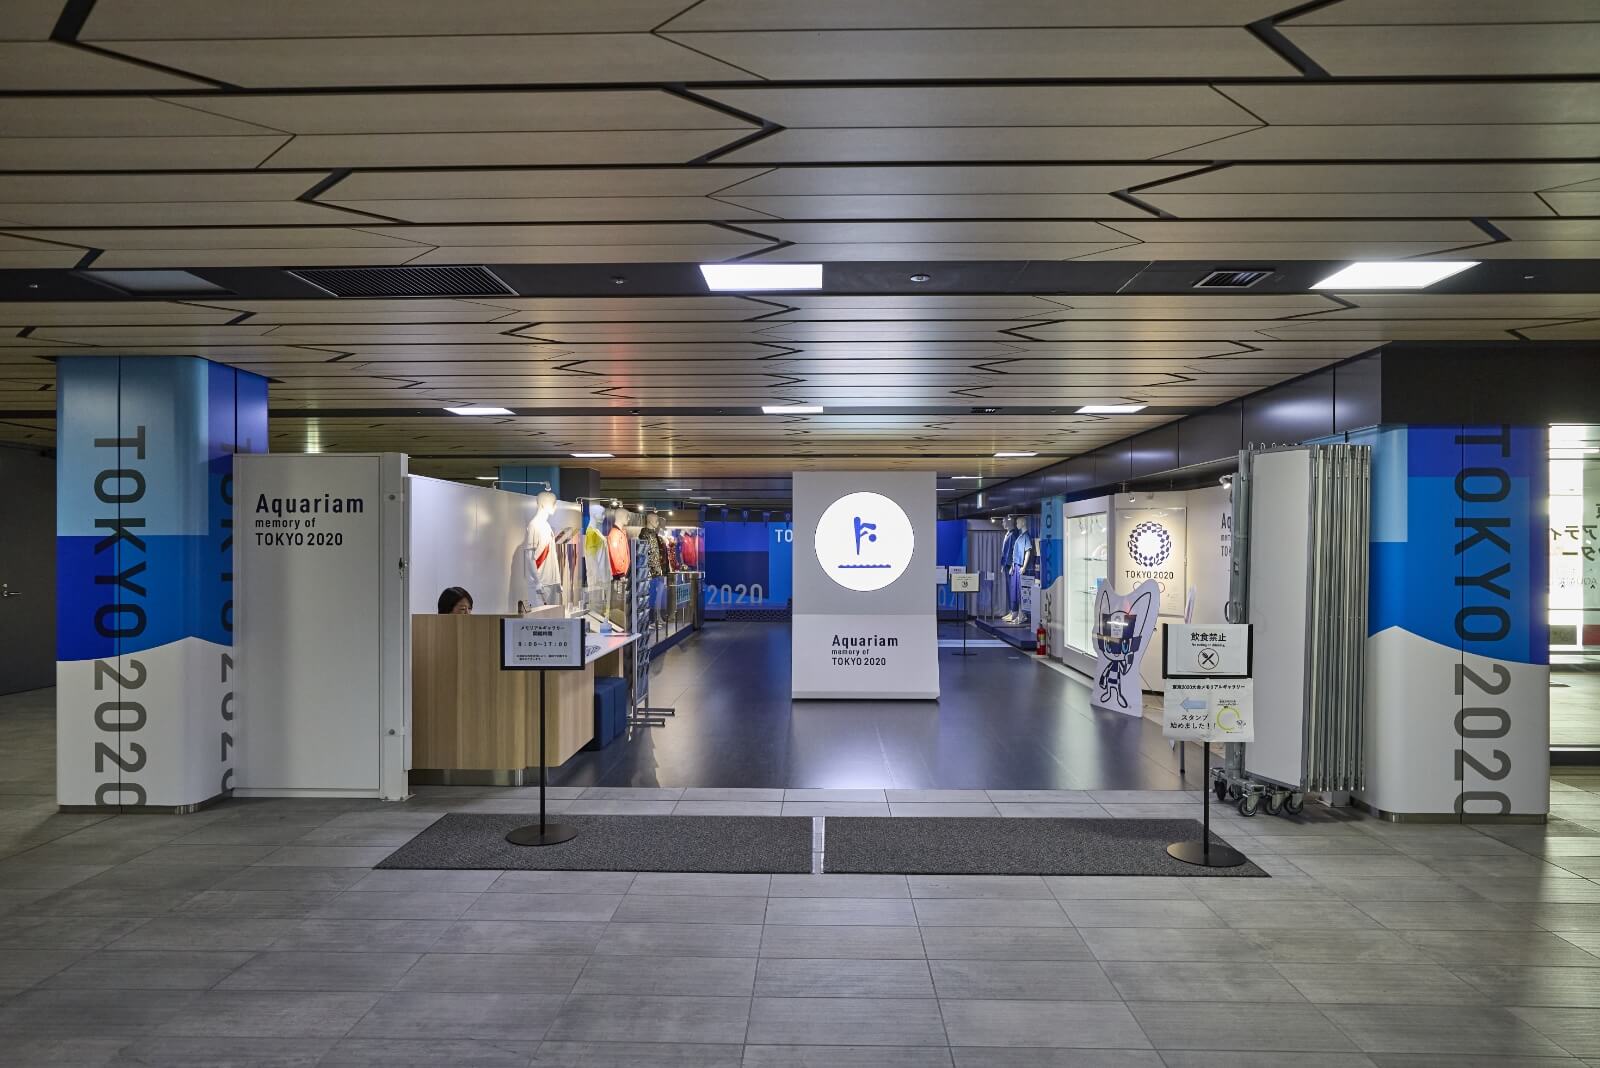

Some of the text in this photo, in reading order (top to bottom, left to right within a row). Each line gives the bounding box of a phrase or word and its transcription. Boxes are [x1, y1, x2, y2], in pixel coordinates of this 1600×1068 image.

[255, 493, 364, 518] Aquariam
[255, 517, 316, 530] memory of
[255, 532, 343, 546] TOKYO 2020
[1125, 570, 1174, 580] TOKYO 2020
[707, 583, 763, 605] 2020
[94, 425, 147, 806] TOKYO 2020
[1453, 423, 1511, 814] TOKYO 2020
[831, 634, 899, 649] Aquariam
[1190, 631, 1227, 642] 飲食禁止
[831, 649, 860, 657] memory
[831, 657, 886, 666] TOKYO 2020
